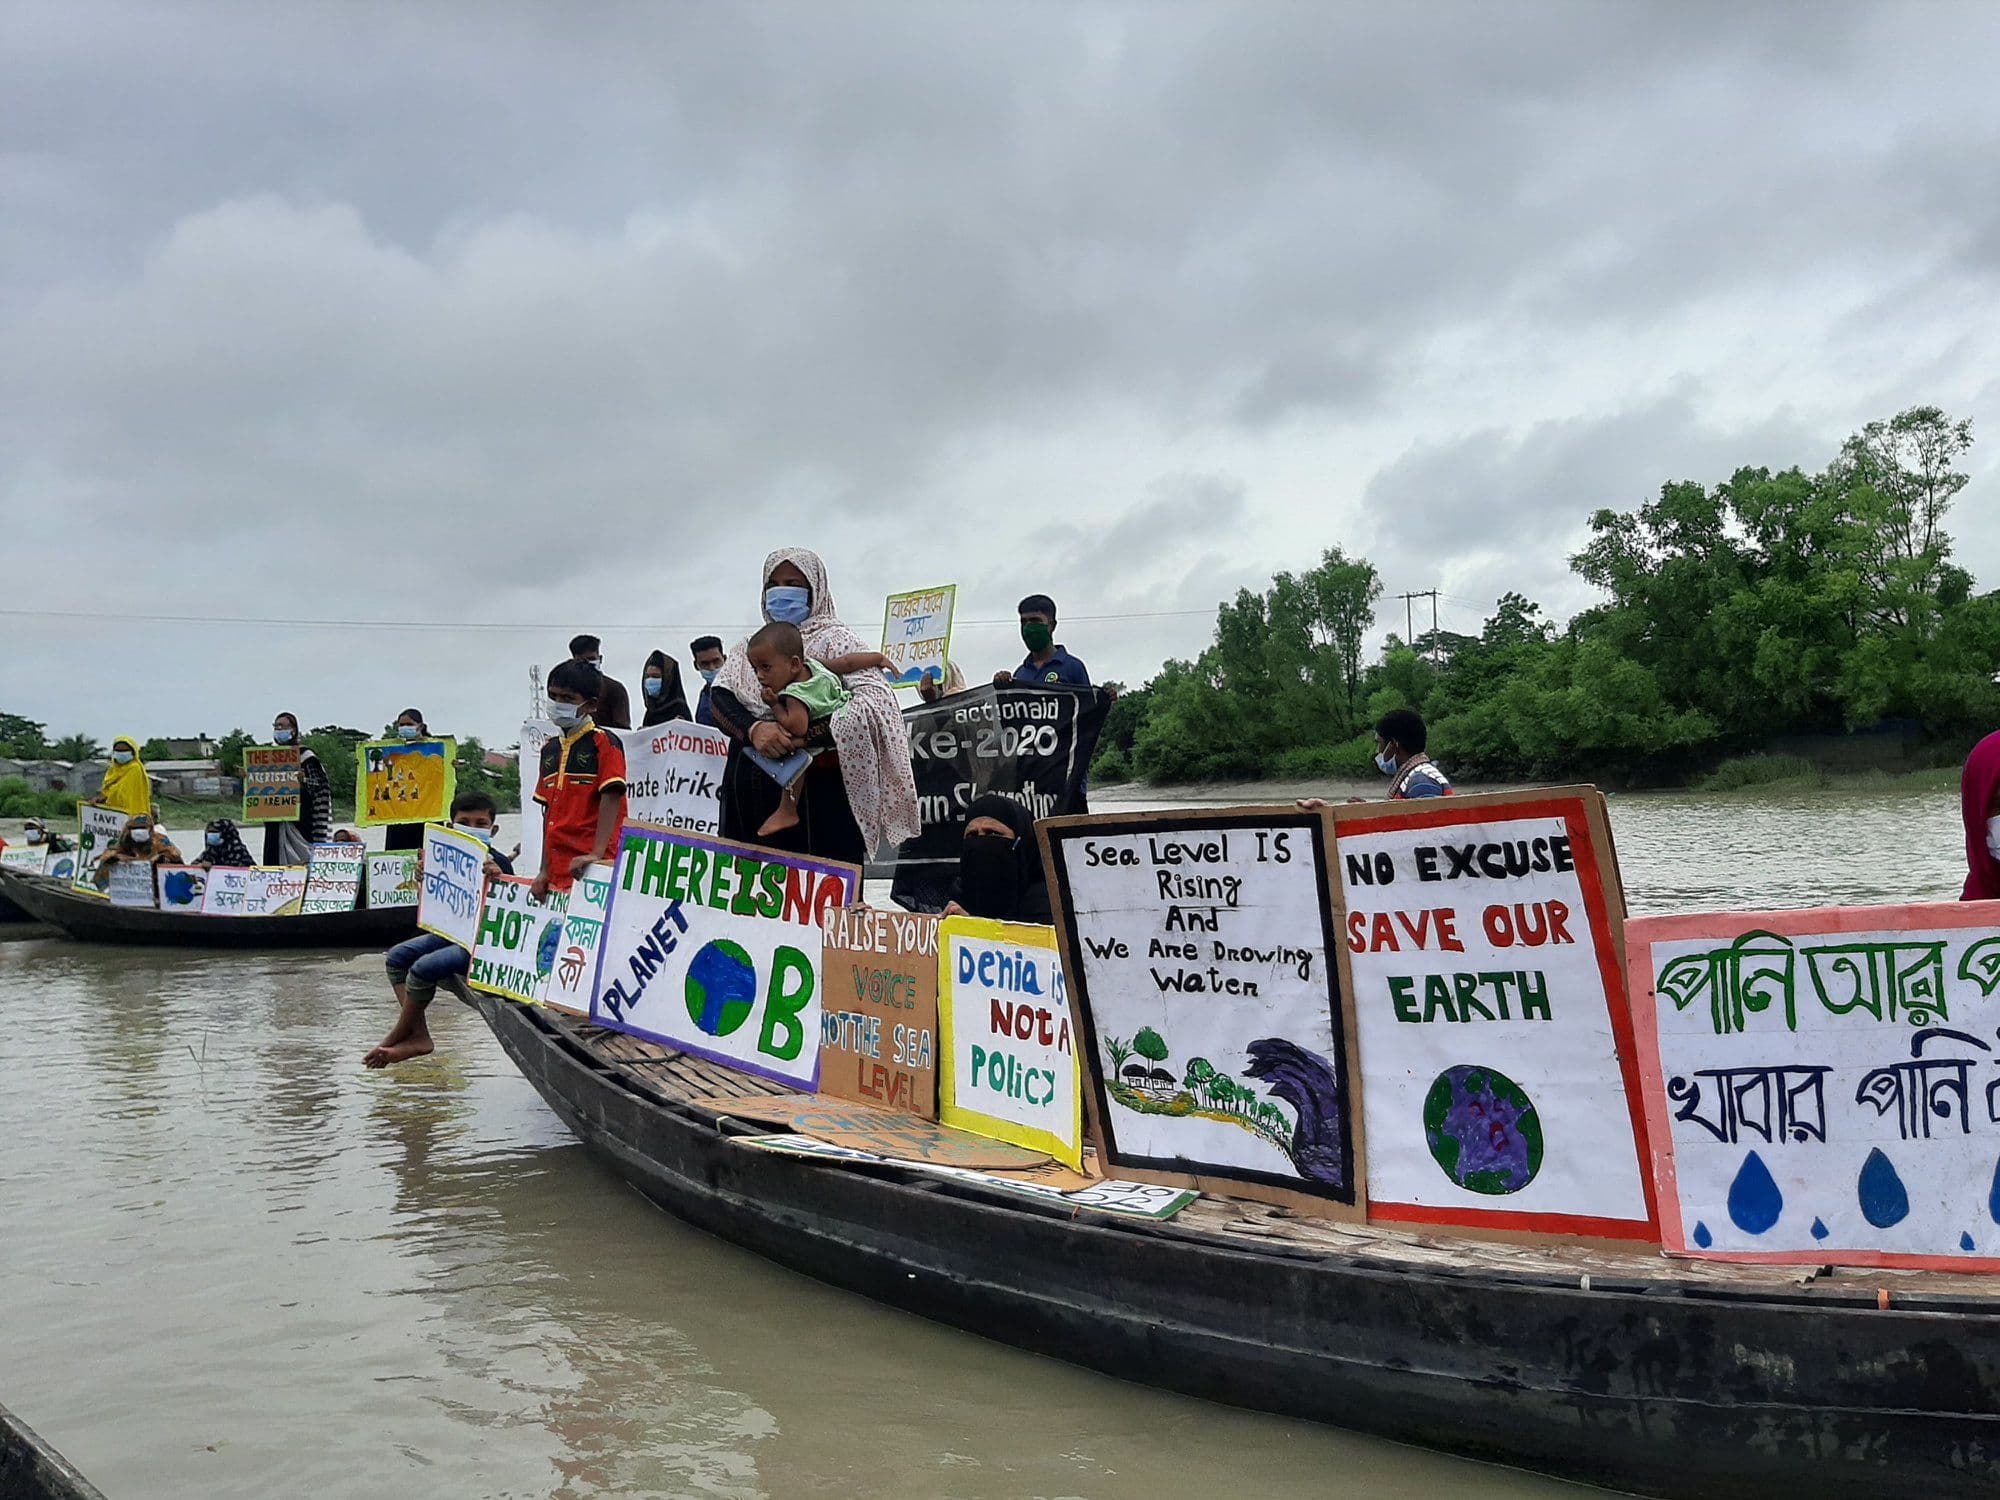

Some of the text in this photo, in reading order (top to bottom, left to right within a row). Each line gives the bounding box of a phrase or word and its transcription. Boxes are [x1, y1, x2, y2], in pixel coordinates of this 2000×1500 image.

[955, 697, 1059, 724] actionaid
[247, 750, 298, 764] THE SEAS
[652, 731, 728, 758] actionaid
[907, 721, 1059, 760] ke-2020
[246, 796, 297, 807] SO ARE WE
[627, 773, 659, 799] mate
[666, 808, 719, 833] Gener
[373, 861, 401, 876] SAVE
[1084, 832, 1292, 867] Sea Level IS
[1345, 835, 1576, 886] NO EXCUSE
[487, 879, 519, 903] ITS
[622, 835, 845, 928] THERE IS NO
[1156, 869, 1243, 907] Rising
[476, 905, 536, 953] HOT
[823, 907, 939, 958] RAISE YOUR
[1165, 905, 1219, 932] And
[1347, 898, 1576, 954] SAVE OUR
[602, 900, 689, 1023] PLANET
[1084, 936, 1131, 960] We
[469, 958, 544, 997] IN HURRY
[852, 964, 917, 1010] VOICE
[1386, 970, 1553, 1024] EARTH
[1656, 929, 1799, 1034] পানি
[1800, 940, 1951, 1027] আর
[758, 945, 816, 1062] B
[820, 1010, 932, 1070] NOT THE SEA
[1058, 1017, 1072, 1056] A
[858, 1058, 921, 1112] LEVEL
[1666, 1064, 1835, 1144] খাবার
[1854, 1026, 1993, 1141] পানি
